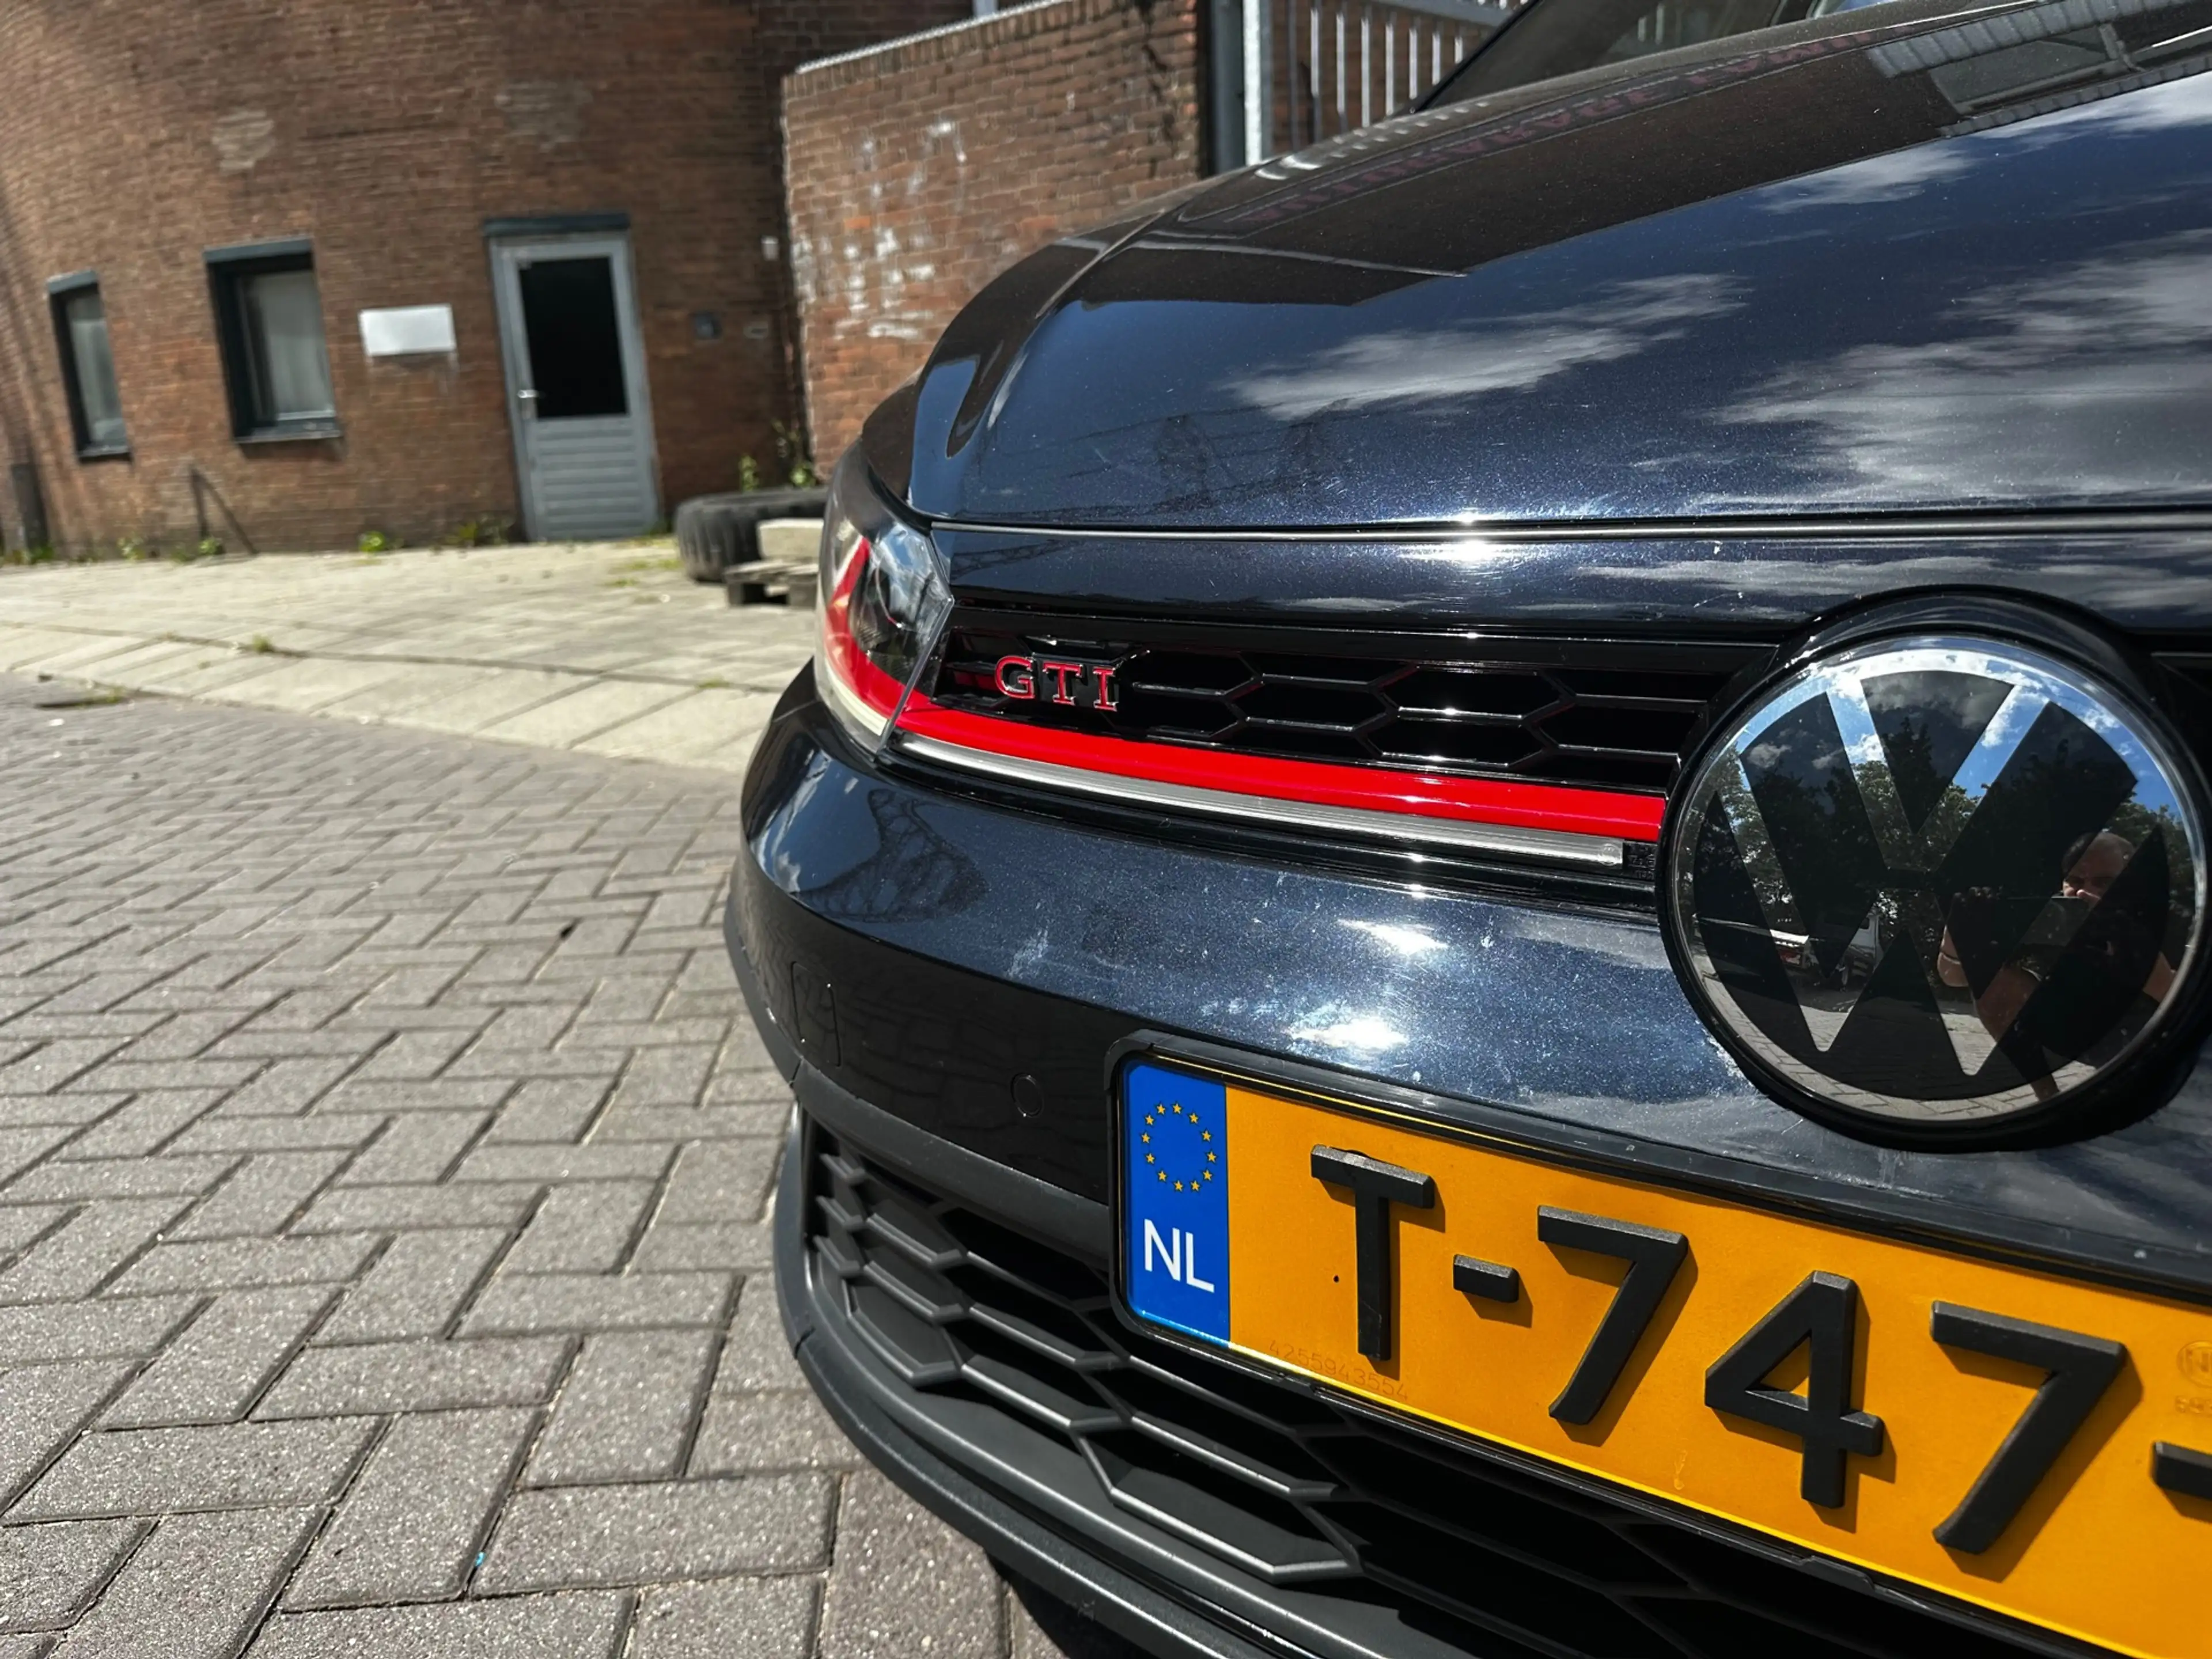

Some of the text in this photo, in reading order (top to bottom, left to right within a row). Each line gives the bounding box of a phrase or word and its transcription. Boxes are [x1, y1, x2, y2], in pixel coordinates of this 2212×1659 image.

[994, 654, 1118, 712] GTI
[1714, 668, 2163, 1078] VW
[1143, 1218, 1215, 1293] NL
[1269, 1339, 1408, 1400] 4255943554
